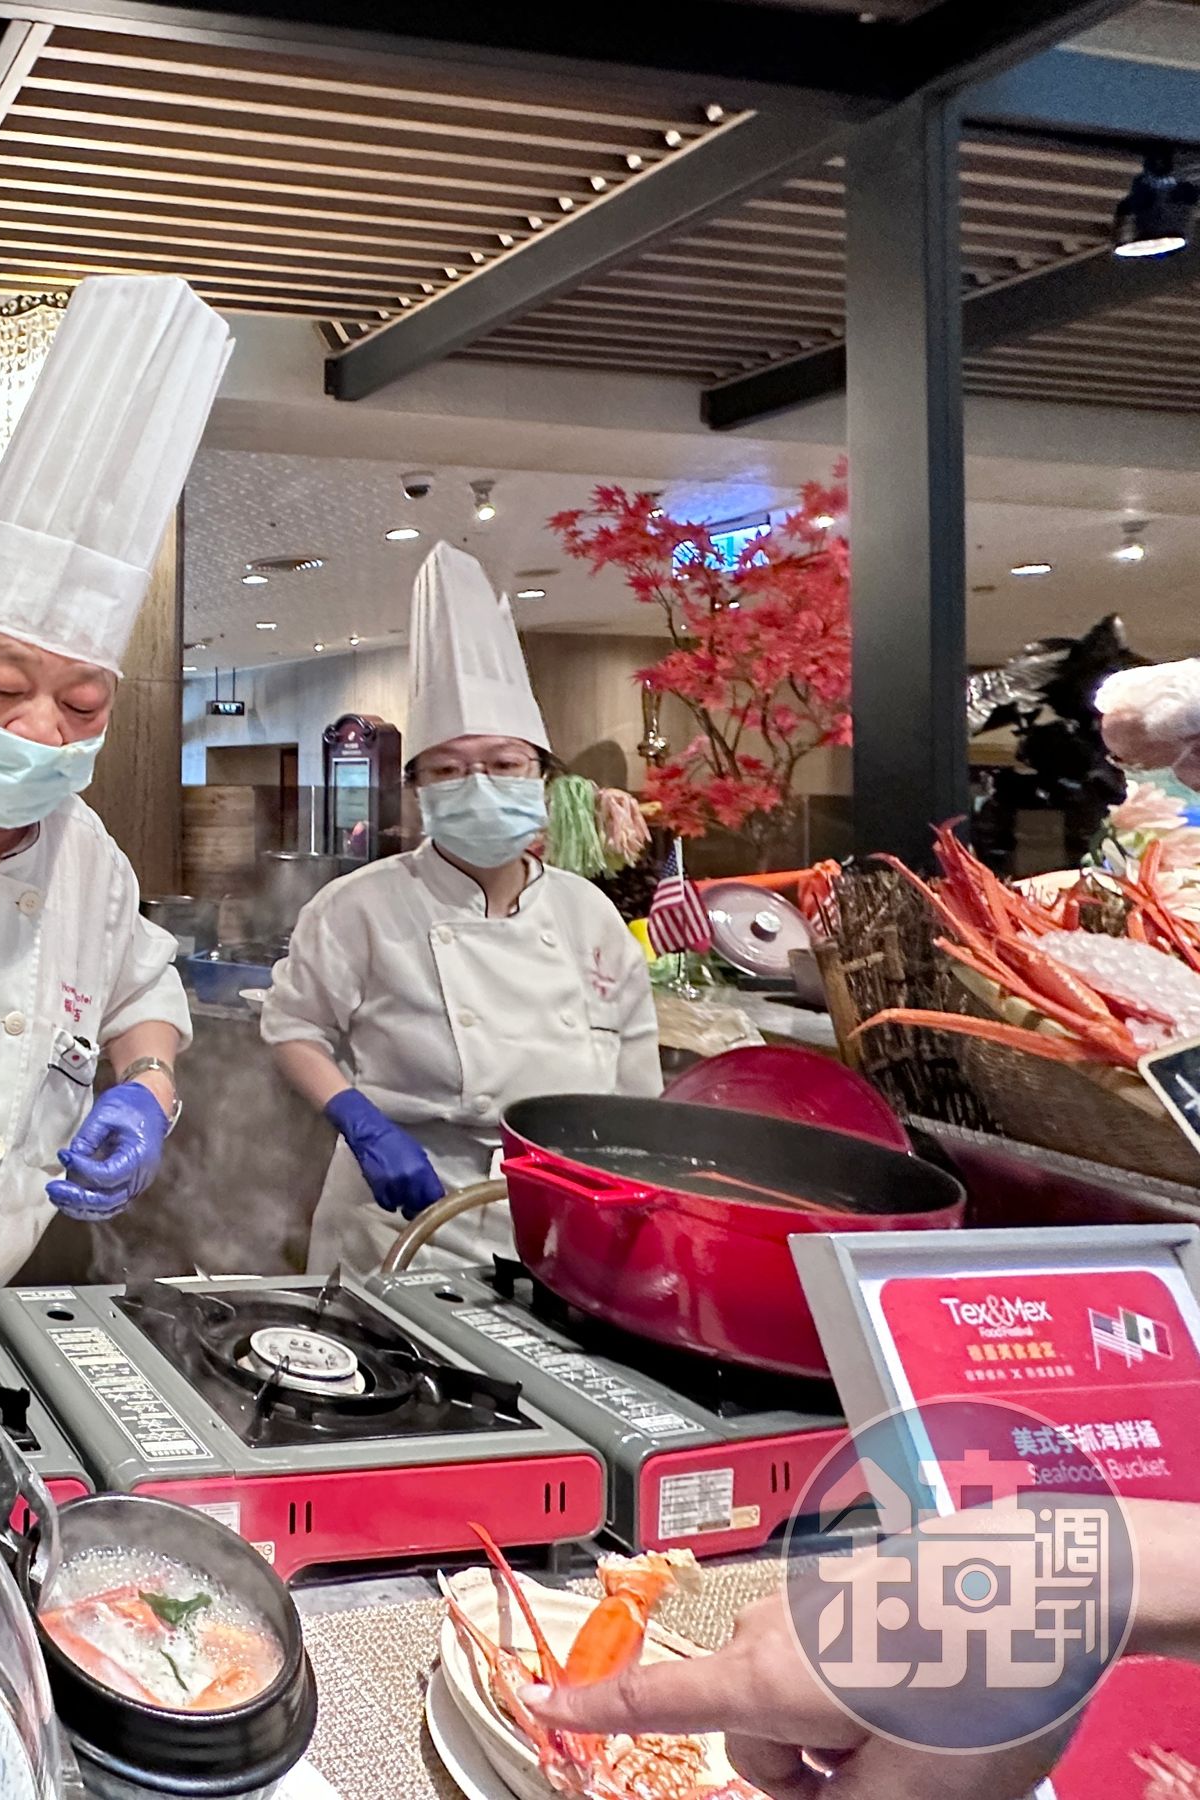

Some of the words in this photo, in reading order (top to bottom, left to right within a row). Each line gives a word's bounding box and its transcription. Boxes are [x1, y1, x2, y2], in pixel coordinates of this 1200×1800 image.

[940, 1294, 1053, 1327] Tex&Mex
[1011, 1420, 1162, 1457] 美式手抓海鮮桶
[1027, 1459, 1106, 1486] Seafood
[1106, 1455, 1172, 1481] Bucket
